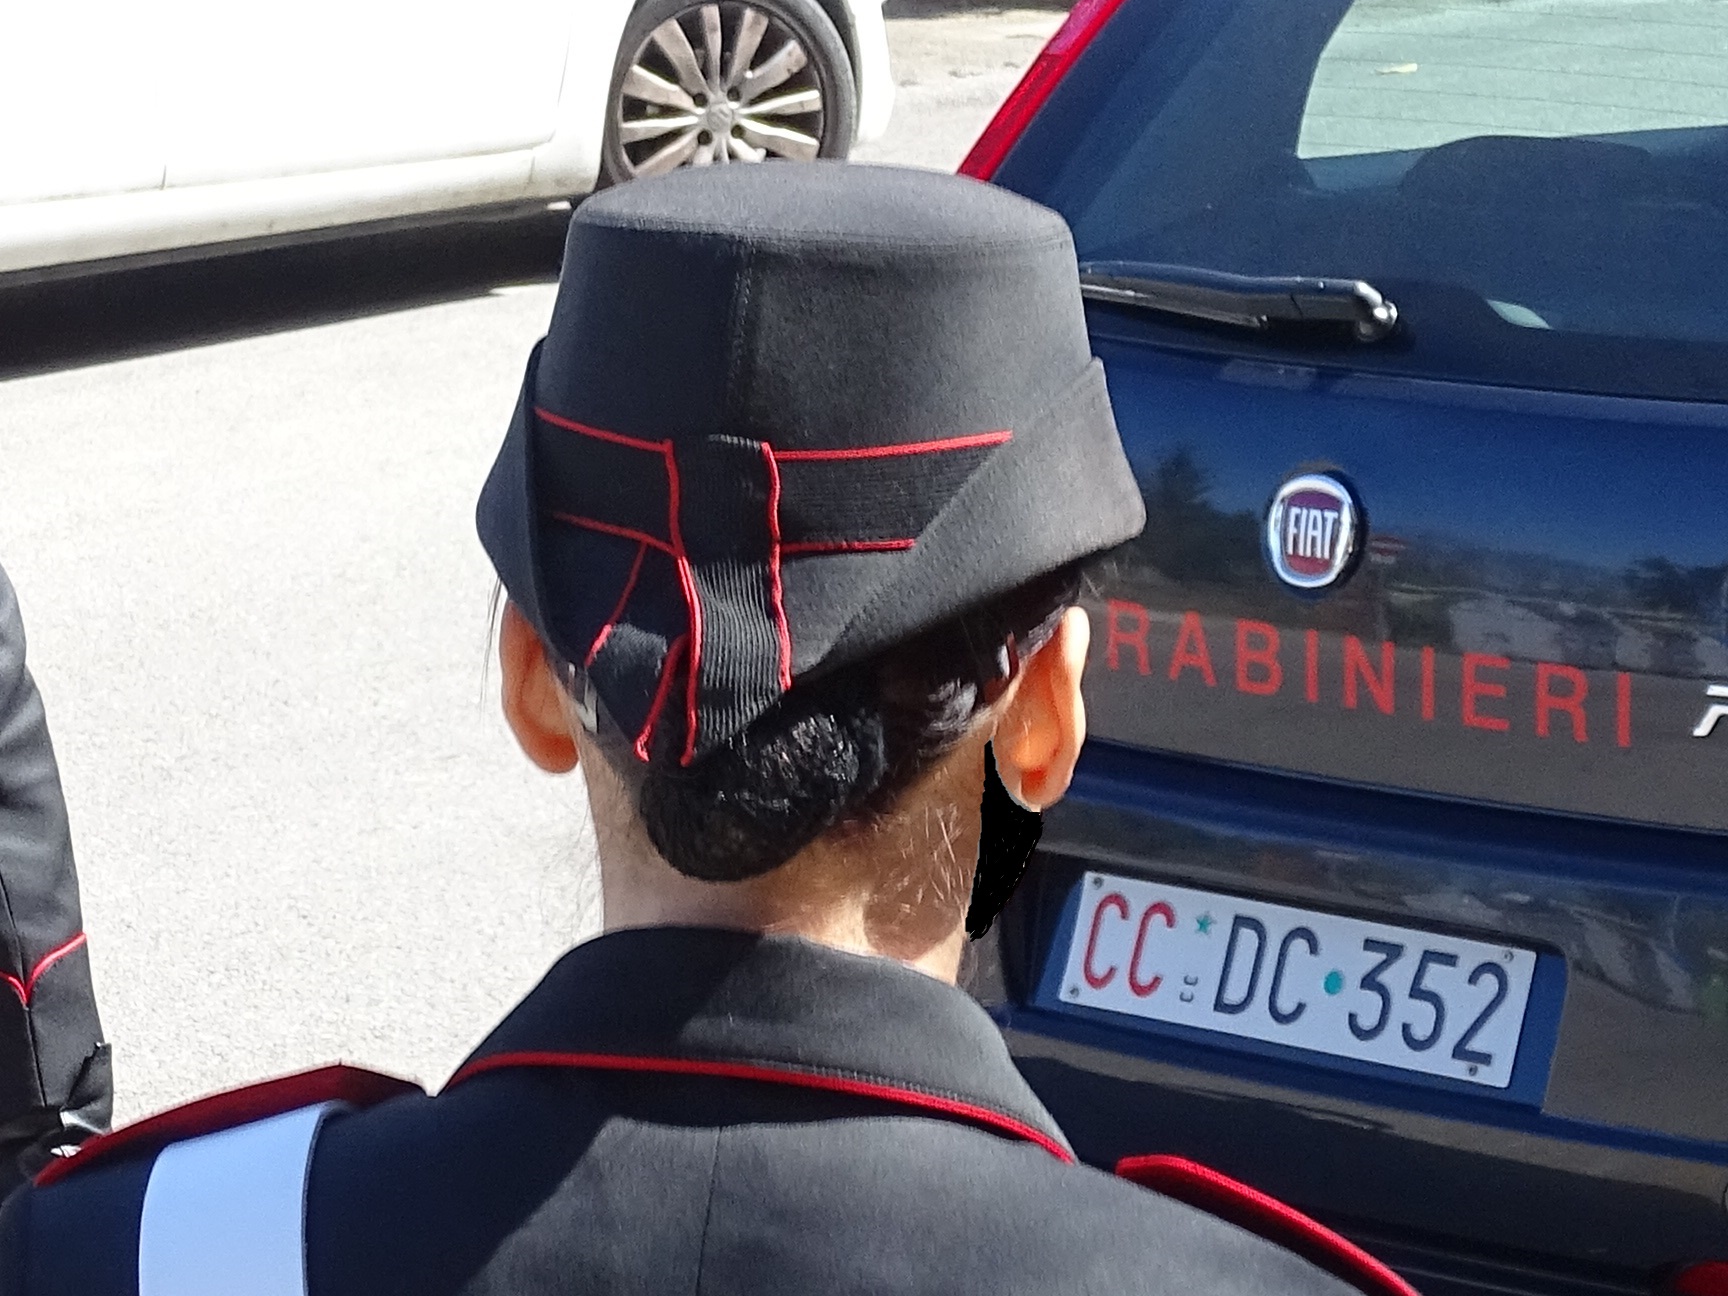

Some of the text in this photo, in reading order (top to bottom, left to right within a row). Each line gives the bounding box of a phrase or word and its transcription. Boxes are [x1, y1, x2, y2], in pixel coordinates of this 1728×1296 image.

[1287, 506, 1338, 560] FIAT
[1083, 891, 1509, 1067] CC DC 352
